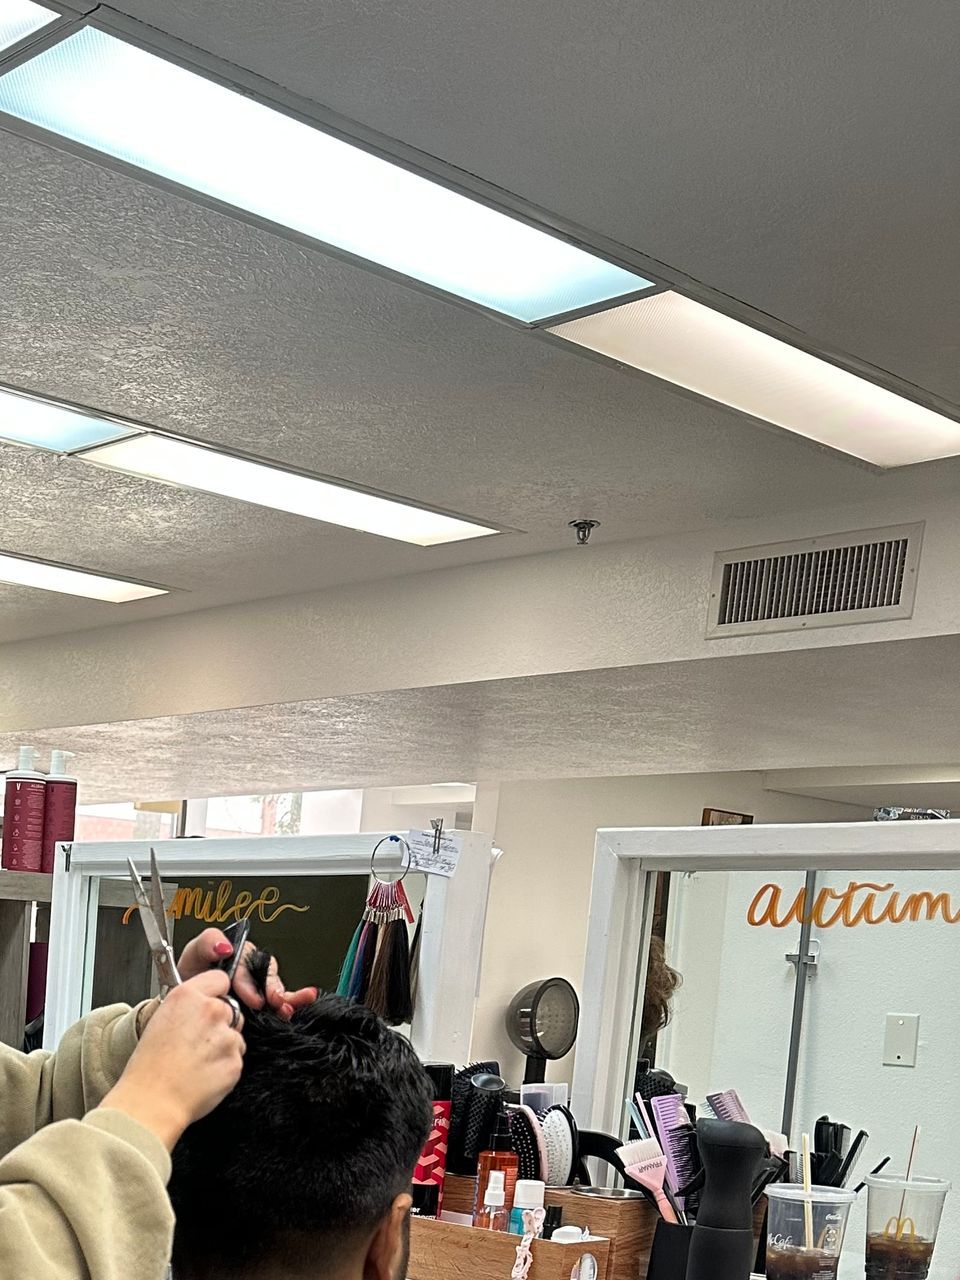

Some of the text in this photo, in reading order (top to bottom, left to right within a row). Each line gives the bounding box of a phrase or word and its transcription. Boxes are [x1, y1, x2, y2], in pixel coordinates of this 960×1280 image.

[121, 879, 310, 925] milee
[746, 880, 960, 928] autum
[637, 1160, 663, 1174] FRAMAR
